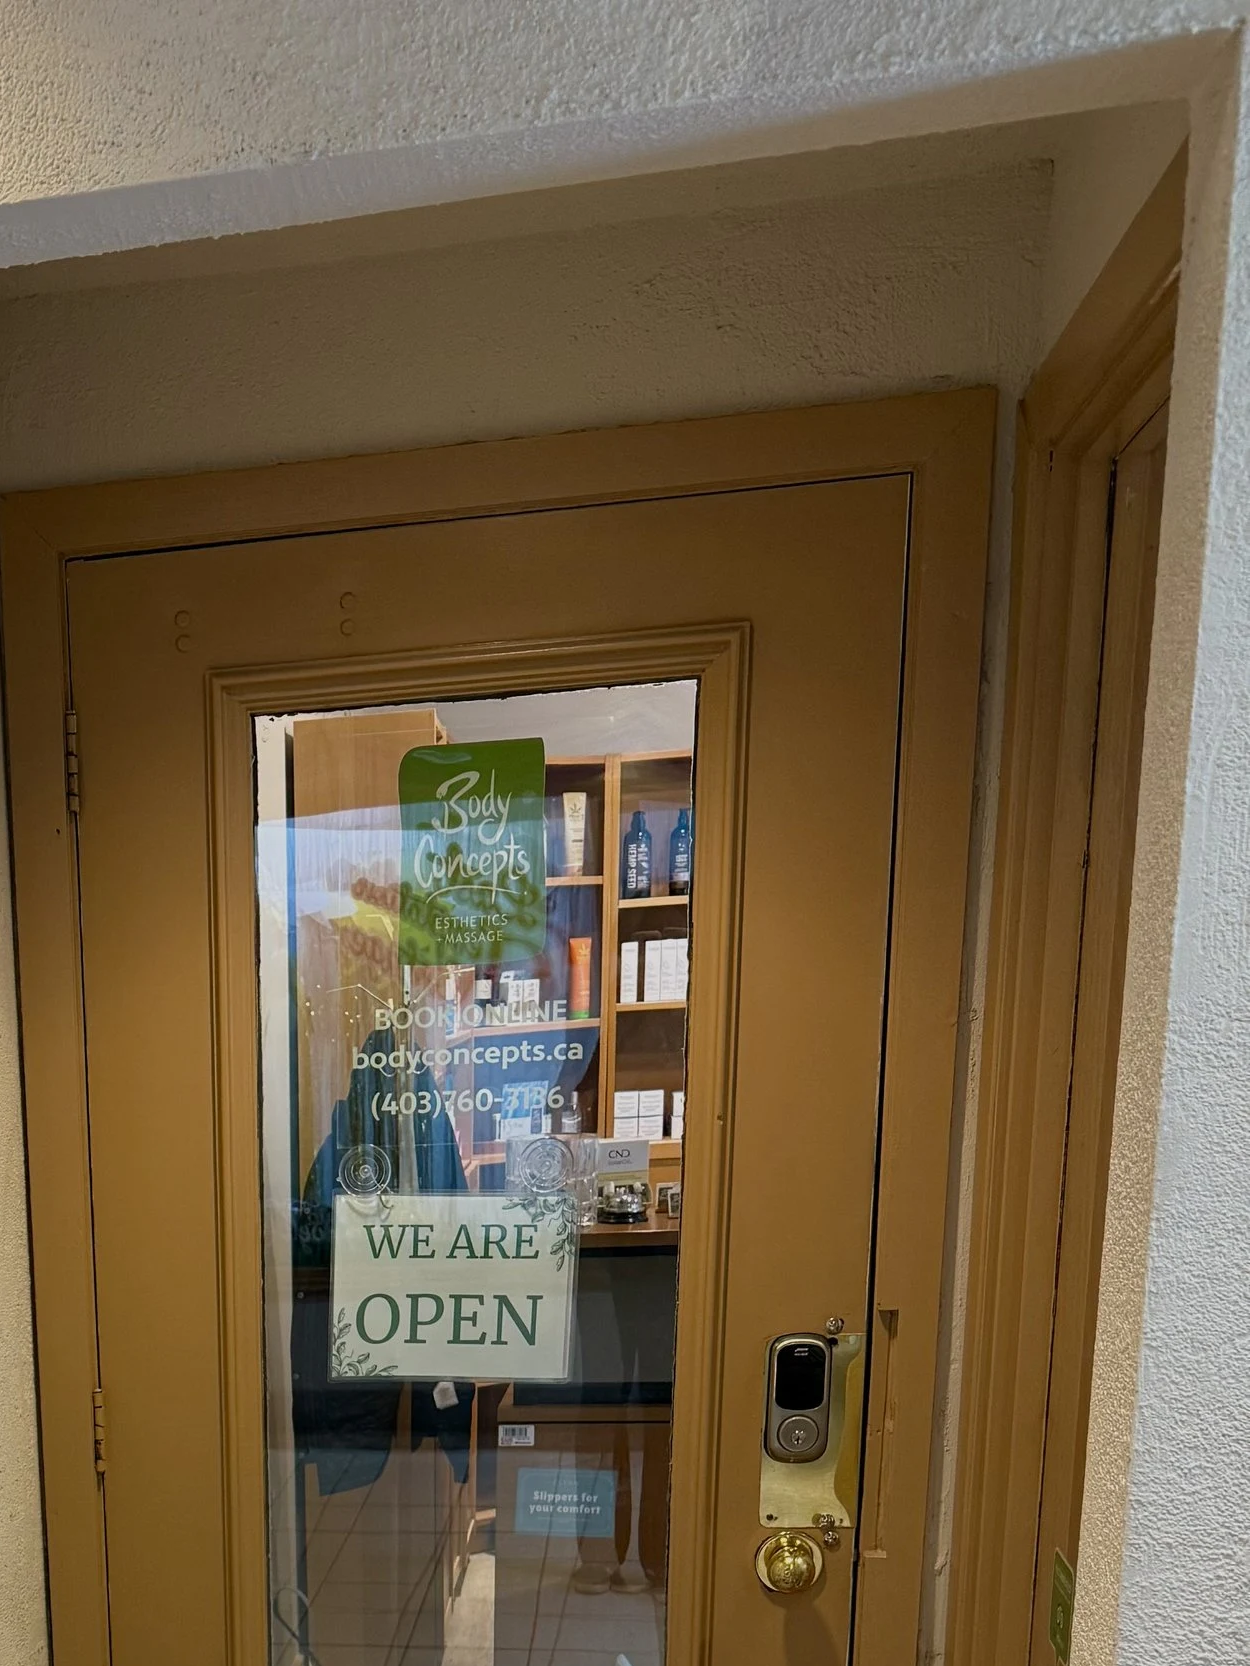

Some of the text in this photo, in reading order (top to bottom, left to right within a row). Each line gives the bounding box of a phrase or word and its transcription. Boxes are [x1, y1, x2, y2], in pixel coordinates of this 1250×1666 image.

[431, 769, 513, 845] Body
[414, 832, 531, 904] Concepts
[627, 844, 637, 868] HEMP
[435, 913, 508, 929] ESTHETICS
[375, 999, 567, 1031] BOOK ONLINE
[352, 1040, 584, 1074] bodyconcepts.ca
[608, 1149, 630, 1159] CND
[363, 1223, 540, 1260] WE ARE
[355, 1293, 543, 1346] OPEN
[529, 1504, 600, 1514] your comfort
[533, 1490, 598, 1503] Slippers for
